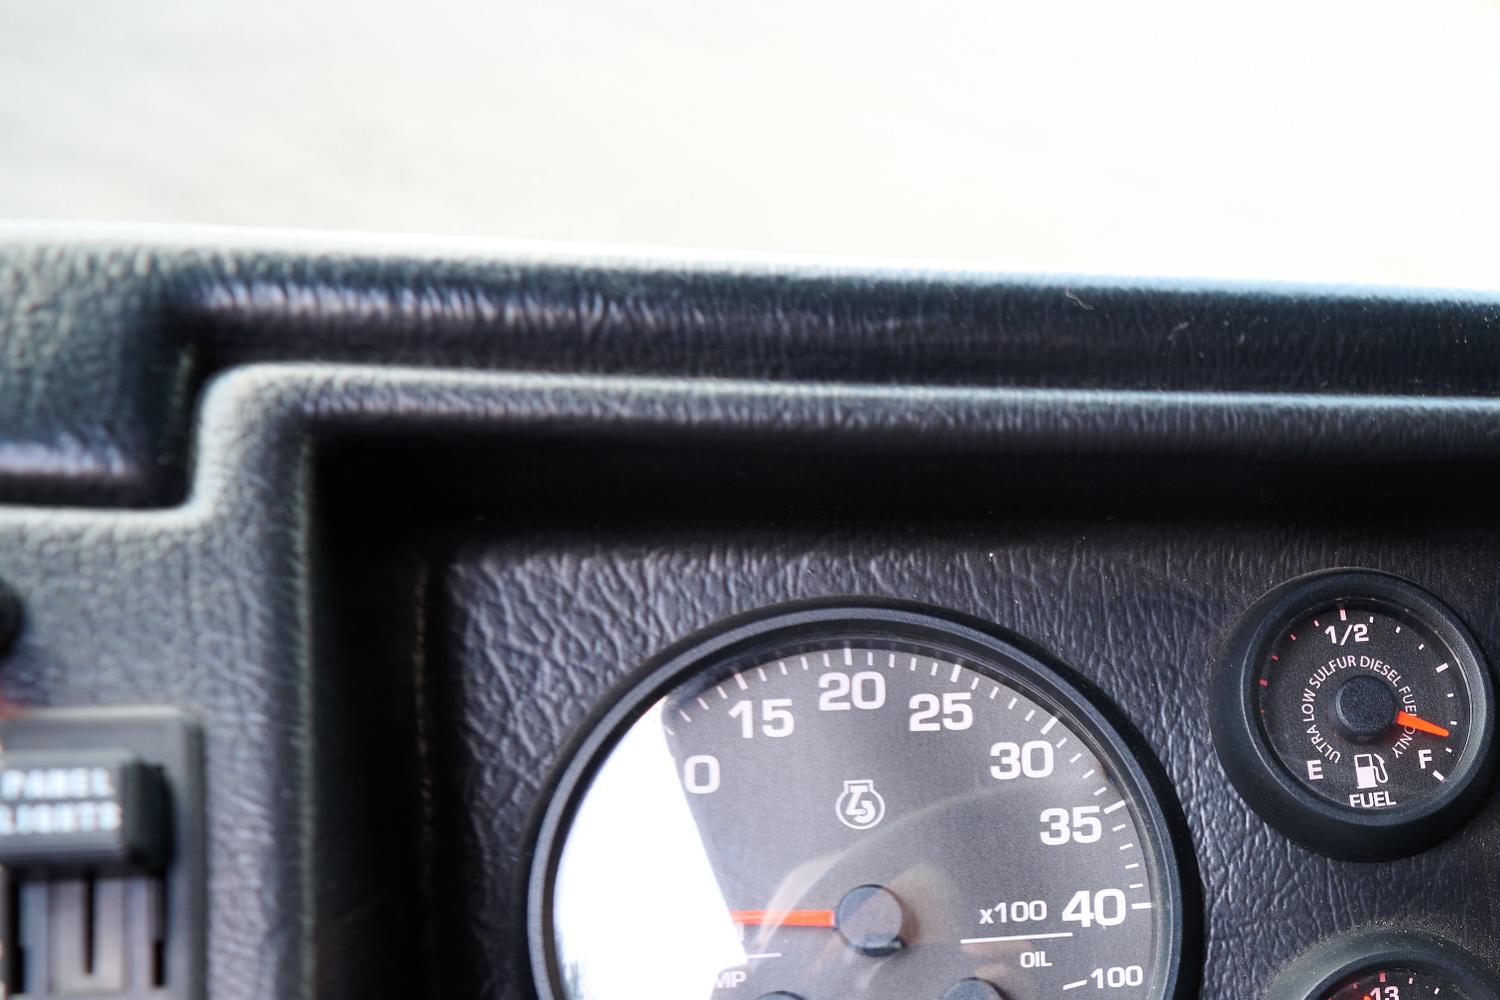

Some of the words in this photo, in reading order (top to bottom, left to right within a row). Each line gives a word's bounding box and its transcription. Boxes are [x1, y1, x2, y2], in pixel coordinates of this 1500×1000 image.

[1324, 623, 1369, 646] 1/2
[1309, 655, 1357, 689] SULFUR
[1359, 656, 1402, 688] DIESEL
[818, 671, 886, 711] 20
[1301, 688, 1317, 722] LOW
[729, 699, 794, 738] 15
[909, 693, 973, 732] 25
[990, 740, 1054, 780] 30
[1306, 724, 1341, 764] ULTRA
[1418, 749, 1433, 770] F
[1306, 759, 1324, 780] E
[1349, 791, 1397, 808] FUEL
[1039, 805, 1101, 846] 35
[979, 900, 1048, 925] x100
[1062, 888, 1127, 928] 40
[1020, 950, 1053, 969] OIL
[1090, 965, 1144, 990] 100
